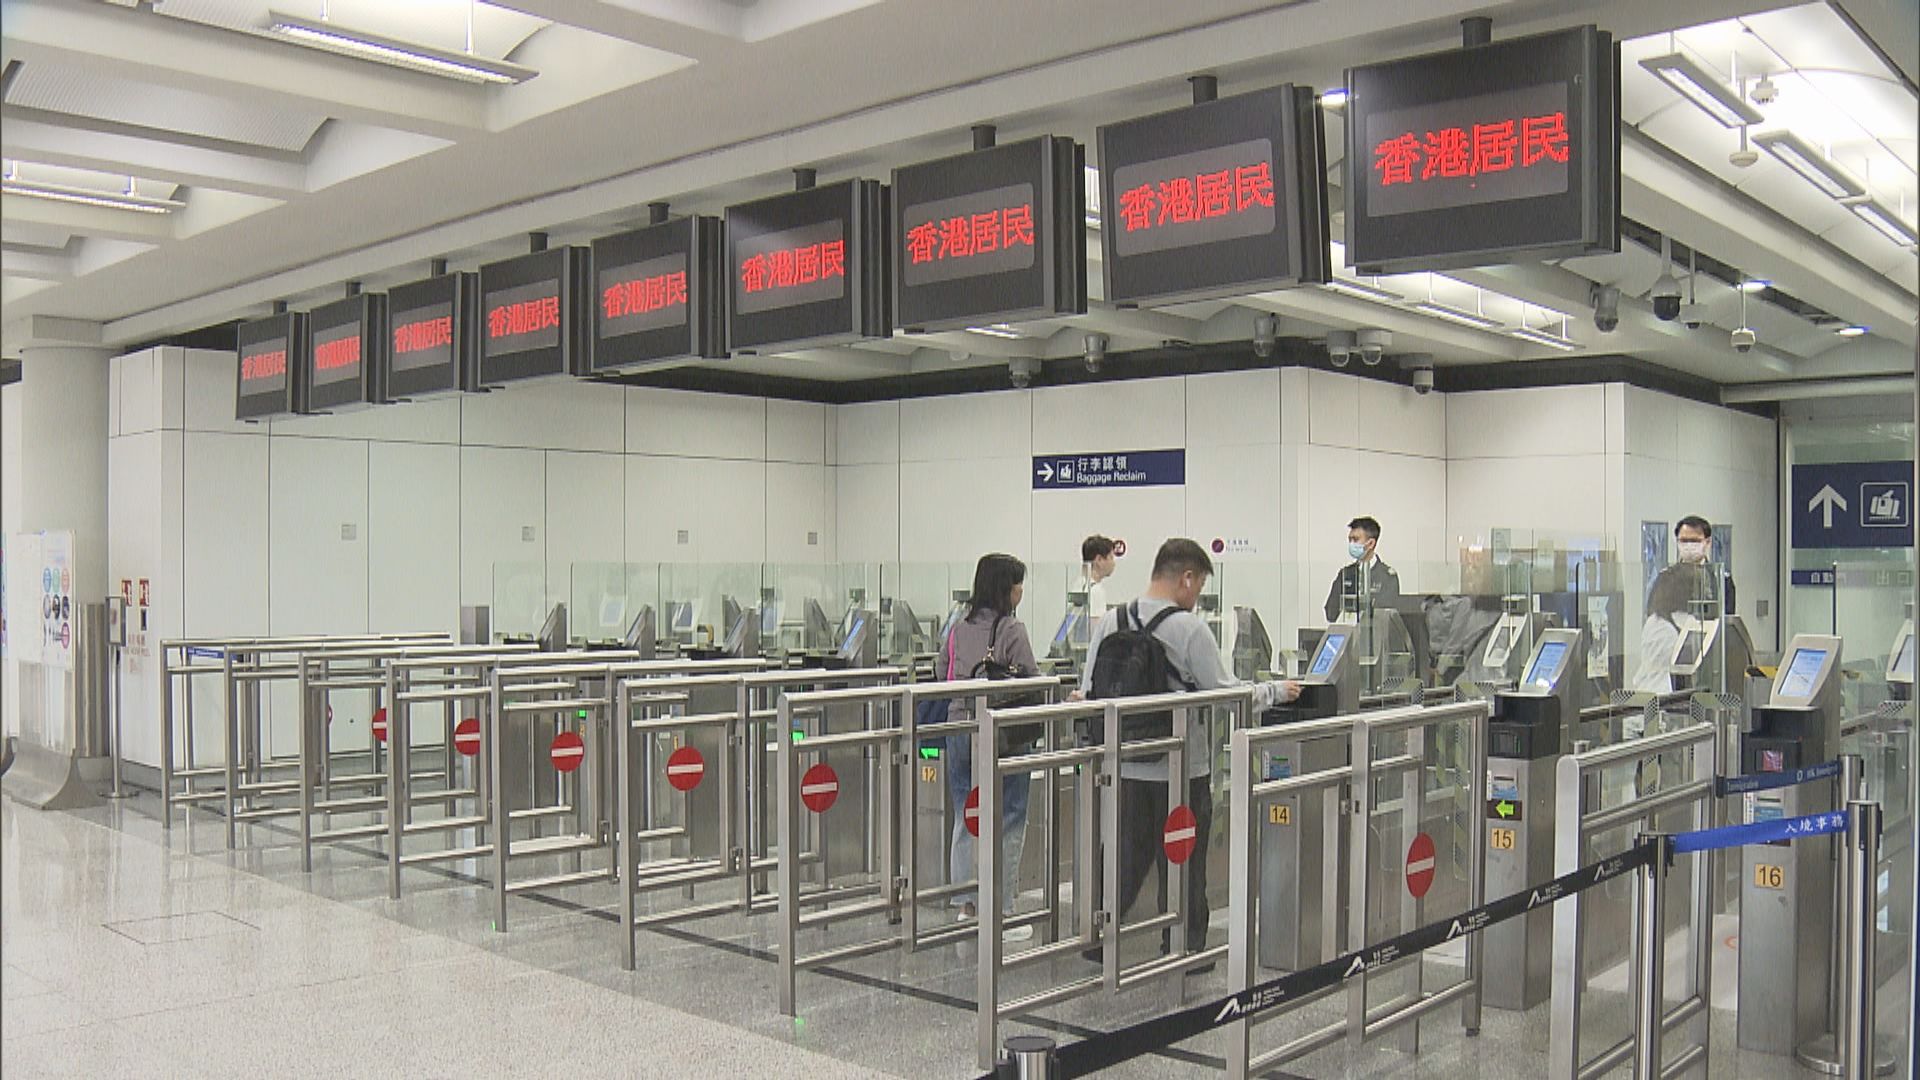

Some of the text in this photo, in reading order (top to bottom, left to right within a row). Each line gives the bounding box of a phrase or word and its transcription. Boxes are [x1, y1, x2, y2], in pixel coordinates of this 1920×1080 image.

[1375, 110, 1570, 187] 香港居民
[1119, 161, 1276, 233] 香港居民
[906, 203, 1036, 265] 香港居民
[740, 239, 847, 293] 香港居民
[602, 271, 689, 319] 香港居民
[488, 296, 561, 338] 香港居民
[394, 316, 453, 353] 香港居民
[1077, 456, 1127, 471] 行李認領
[1077, 469, 1146, 485] Baggage Reclaim
[924, 767, 936, 783] 12
[1272, 805, 1288, 823] 14
[1785, 815, 1844, 834] 入境事務
[1493, 829, 1512, 849] 15
[1759, 866, 1781, 887] 16
